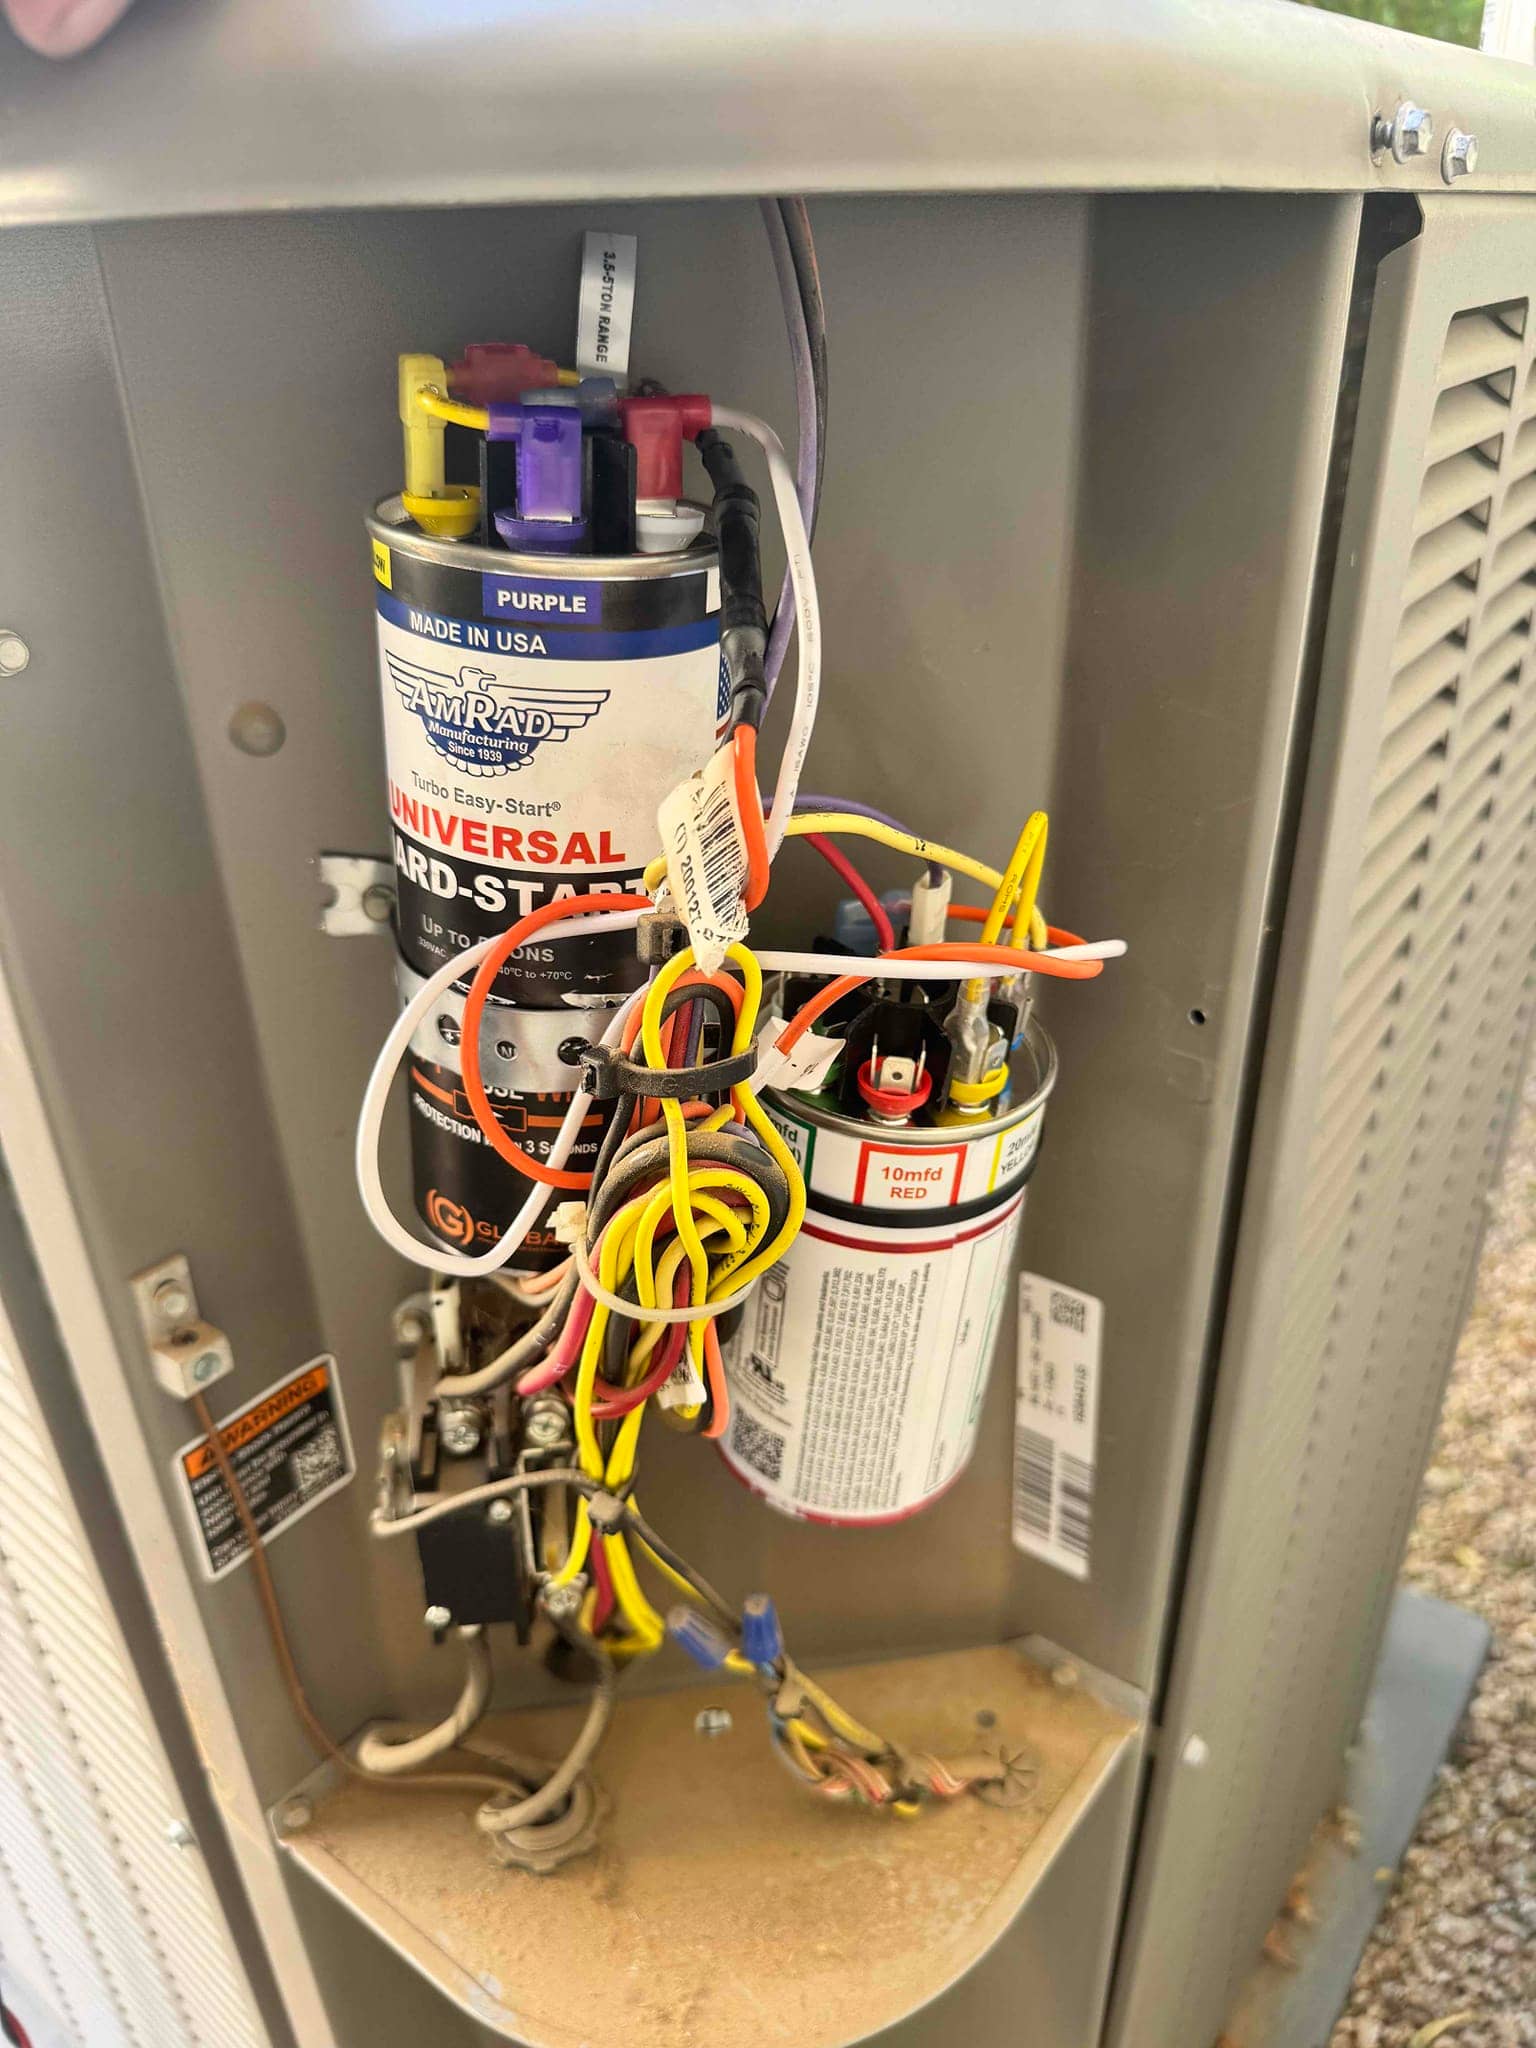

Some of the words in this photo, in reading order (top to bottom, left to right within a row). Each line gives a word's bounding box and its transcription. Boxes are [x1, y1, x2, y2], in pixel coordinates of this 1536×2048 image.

[595, 315, 611, 363] RANGE
[496, 590, 587, 613] PURPLE
[410, 611, 462, 643] MADE
[467, 626, 489, 648] IN
[496, 631, 547, 655] USA
[428, 719, 529, 754] Manufacturing
[447, 740, 476, 759] Since
[478, 747, 503, 762] 1939
[411, 771, 449, 799] Turbo
[388, 778, 627, 866] UNIVERSAL
[421, 913, 443, 938] UP
[447, 929, 471, 949] TO
[508, 946, 555, 963] ONS
[525, 969, 537, 979] to
[525, 1140, 535, 1154] 3
[880, 1165, 943, 1182] 10mfd
[890, 1187, 927, 1199] RED
[475, 1220, 562, 1246] GLBA
